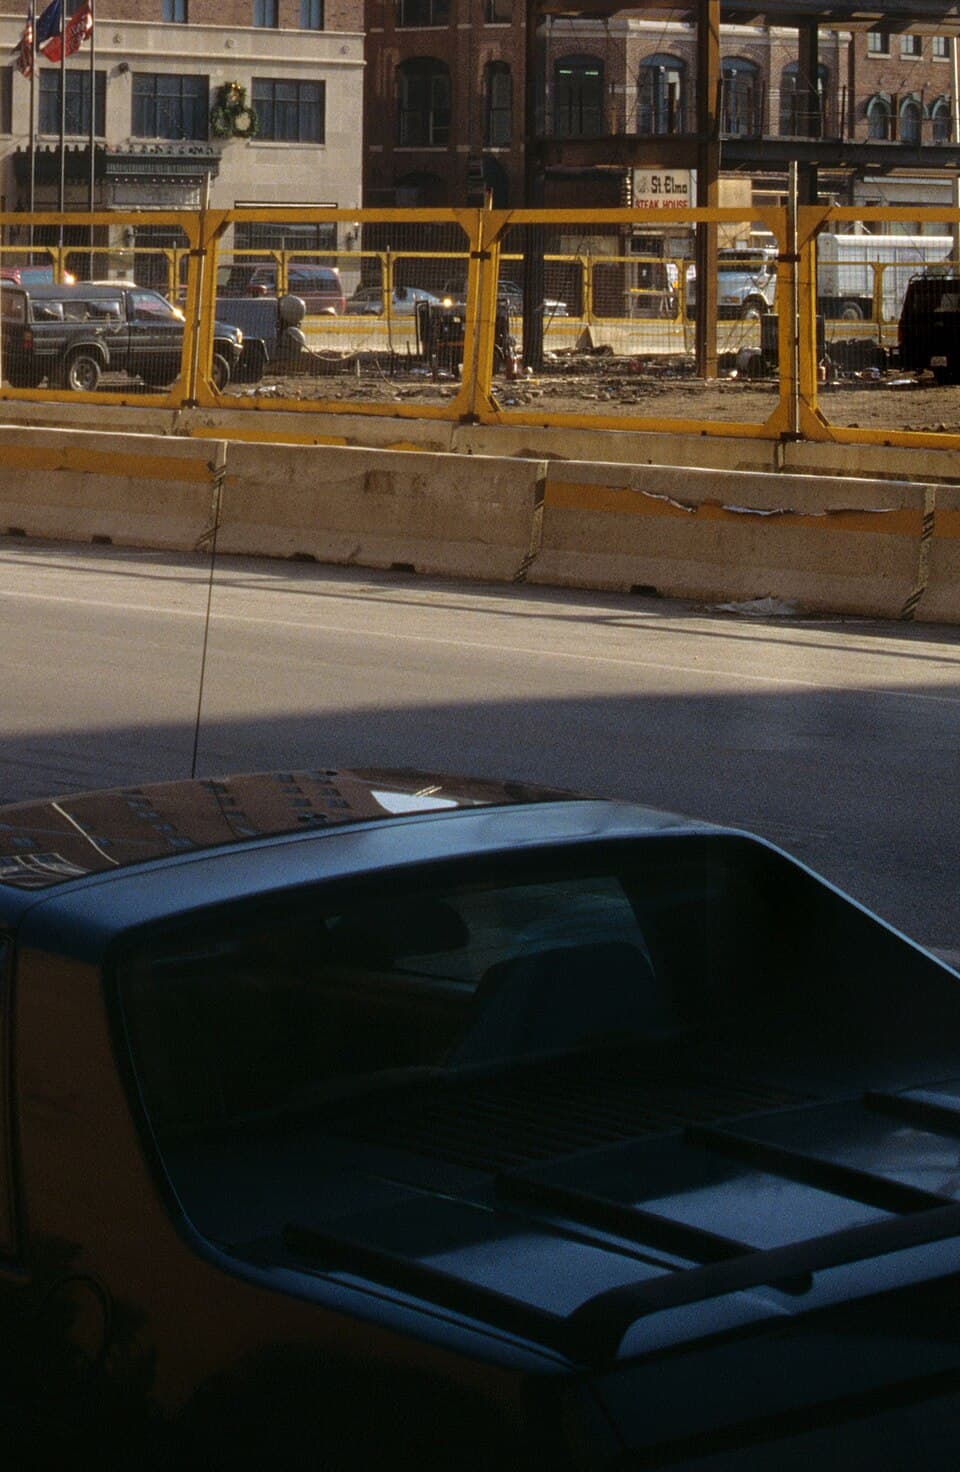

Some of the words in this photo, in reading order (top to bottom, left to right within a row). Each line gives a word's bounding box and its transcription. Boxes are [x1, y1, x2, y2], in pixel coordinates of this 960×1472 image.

[664, 176, 688, 194] Elmo
[635, 199, 659, 208] STEAK
[663, 199, 688, 208] HOUSE
